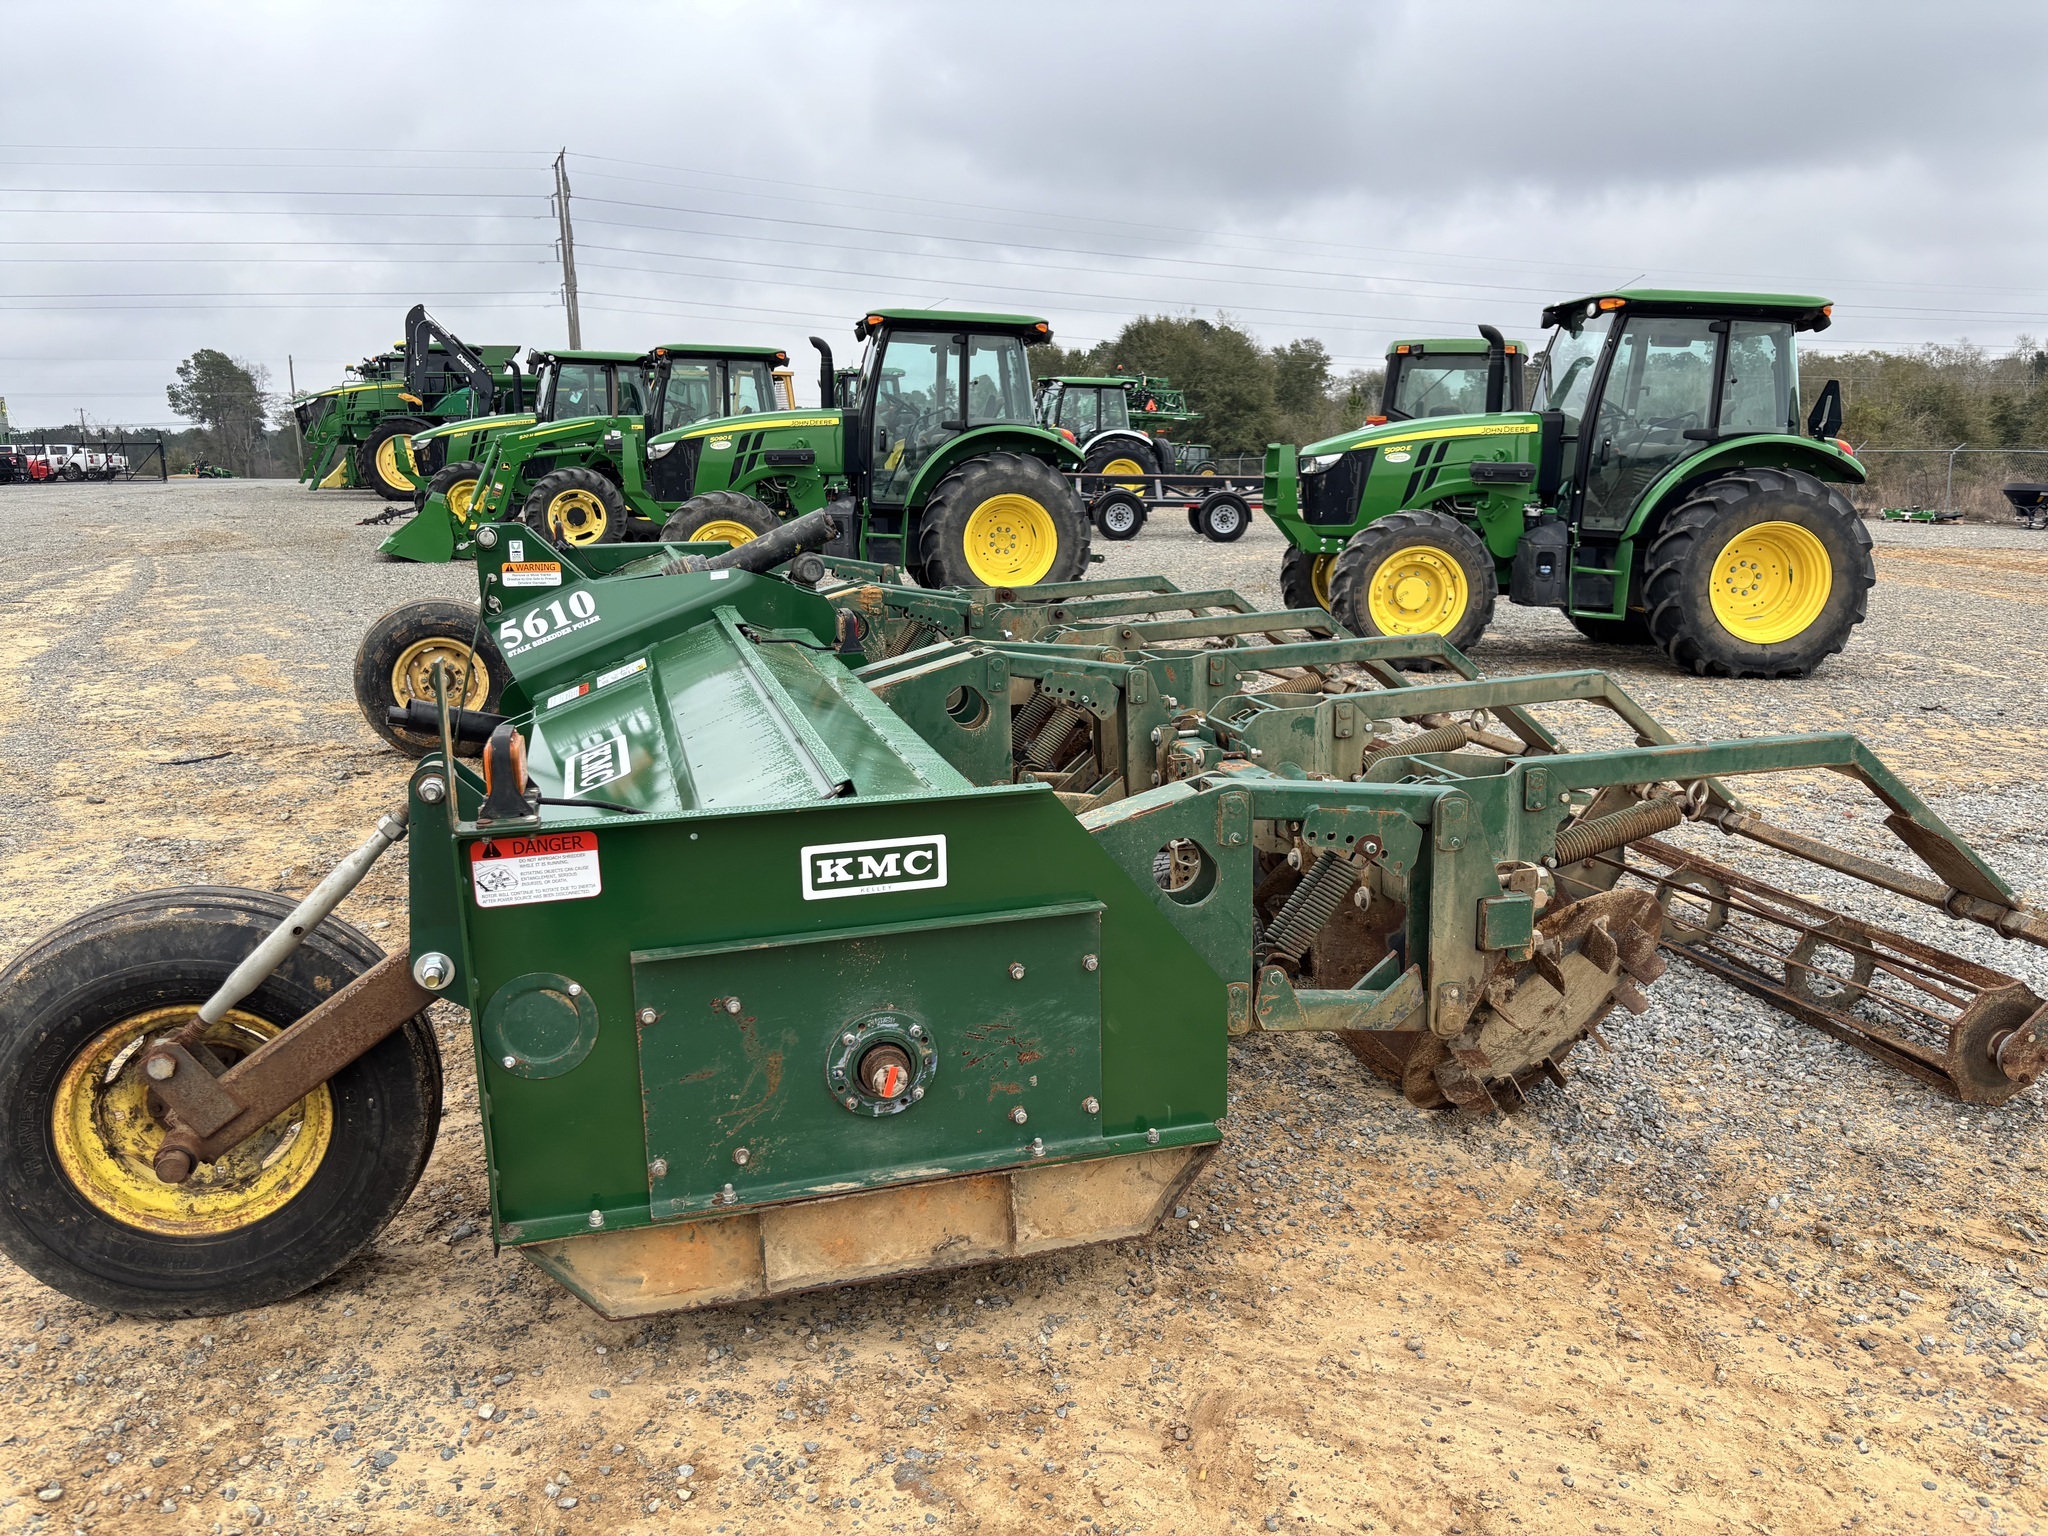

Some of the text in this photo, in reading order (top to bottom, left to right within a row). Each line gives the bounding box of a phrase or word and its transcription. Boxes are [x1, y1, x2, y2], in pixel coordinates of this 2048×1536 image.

[456, 353, 477, 374] DEERE
[515, 563, 556, 572] WARNING
[500, 590, 596, 649] 5610
[507, 615, 602, 658] STALK SHREDDER PULLER
[579, 742, 615, 788] KMC
[512, 836, 584, 855] DANGER
[816, 850, 932, 884] KMC
[860, 885, 892, 893] KELLEY
[18, 1044, 66, 1176] HARVEST KING
